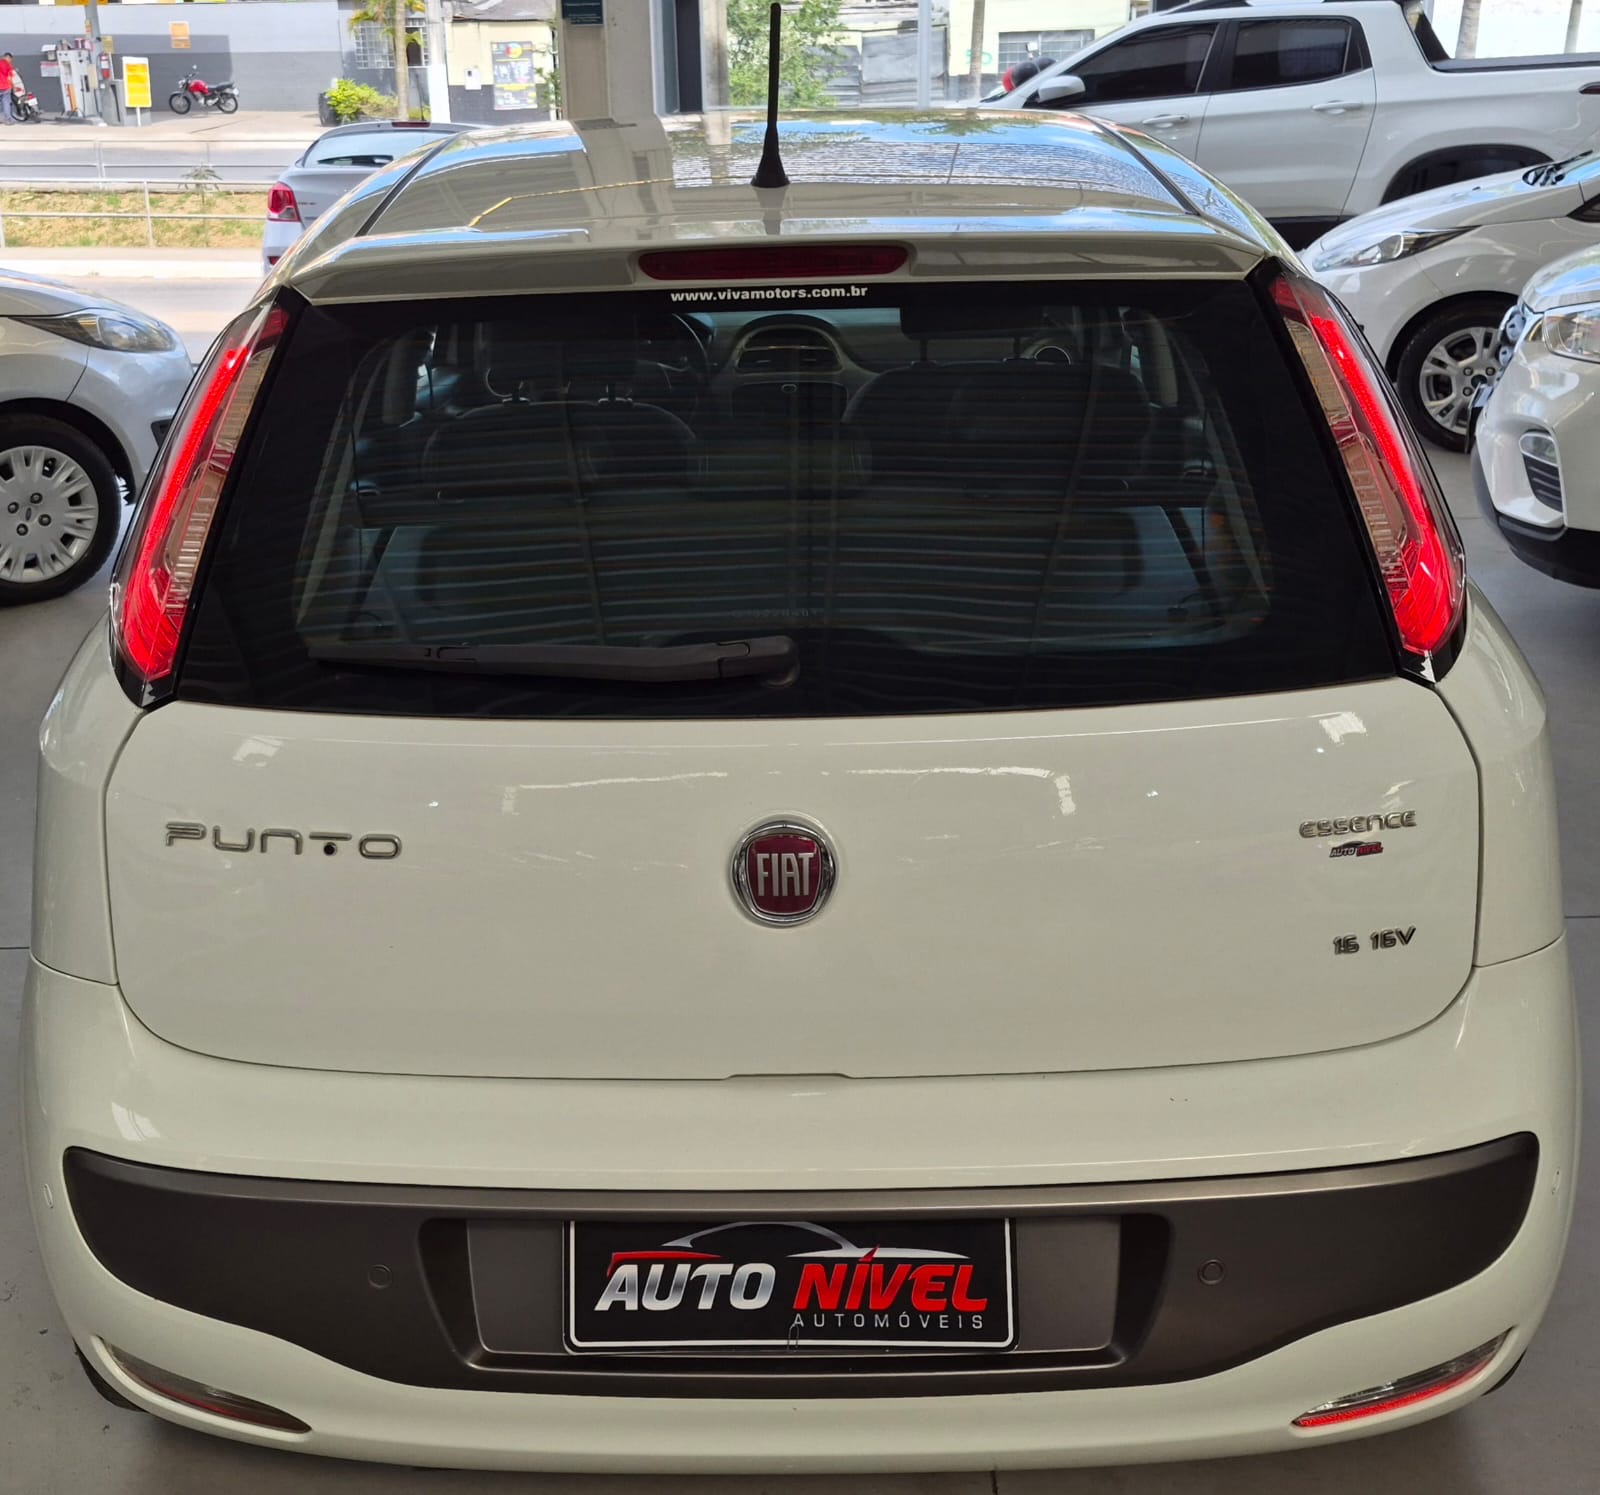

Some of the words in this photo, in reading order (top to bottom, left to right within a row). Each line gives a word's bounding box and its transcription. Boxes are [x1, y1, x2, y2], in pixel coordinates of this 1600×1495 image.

[671, 286, 868, 302] www.vivamotors.com.br
[1299, 810, 1417, 839] ESSENCE
[166, 821, 402, 859] PUNTO
[756, 852, 815, 897] FIAT
[1370, 925, 1417, 950] 16V
[594, 1262, 776, 1311] AUTO
[793, 1245, 988, 1312] NÍVEL
[793, 1311, 983, 1330] AUTOMÓVEIS
